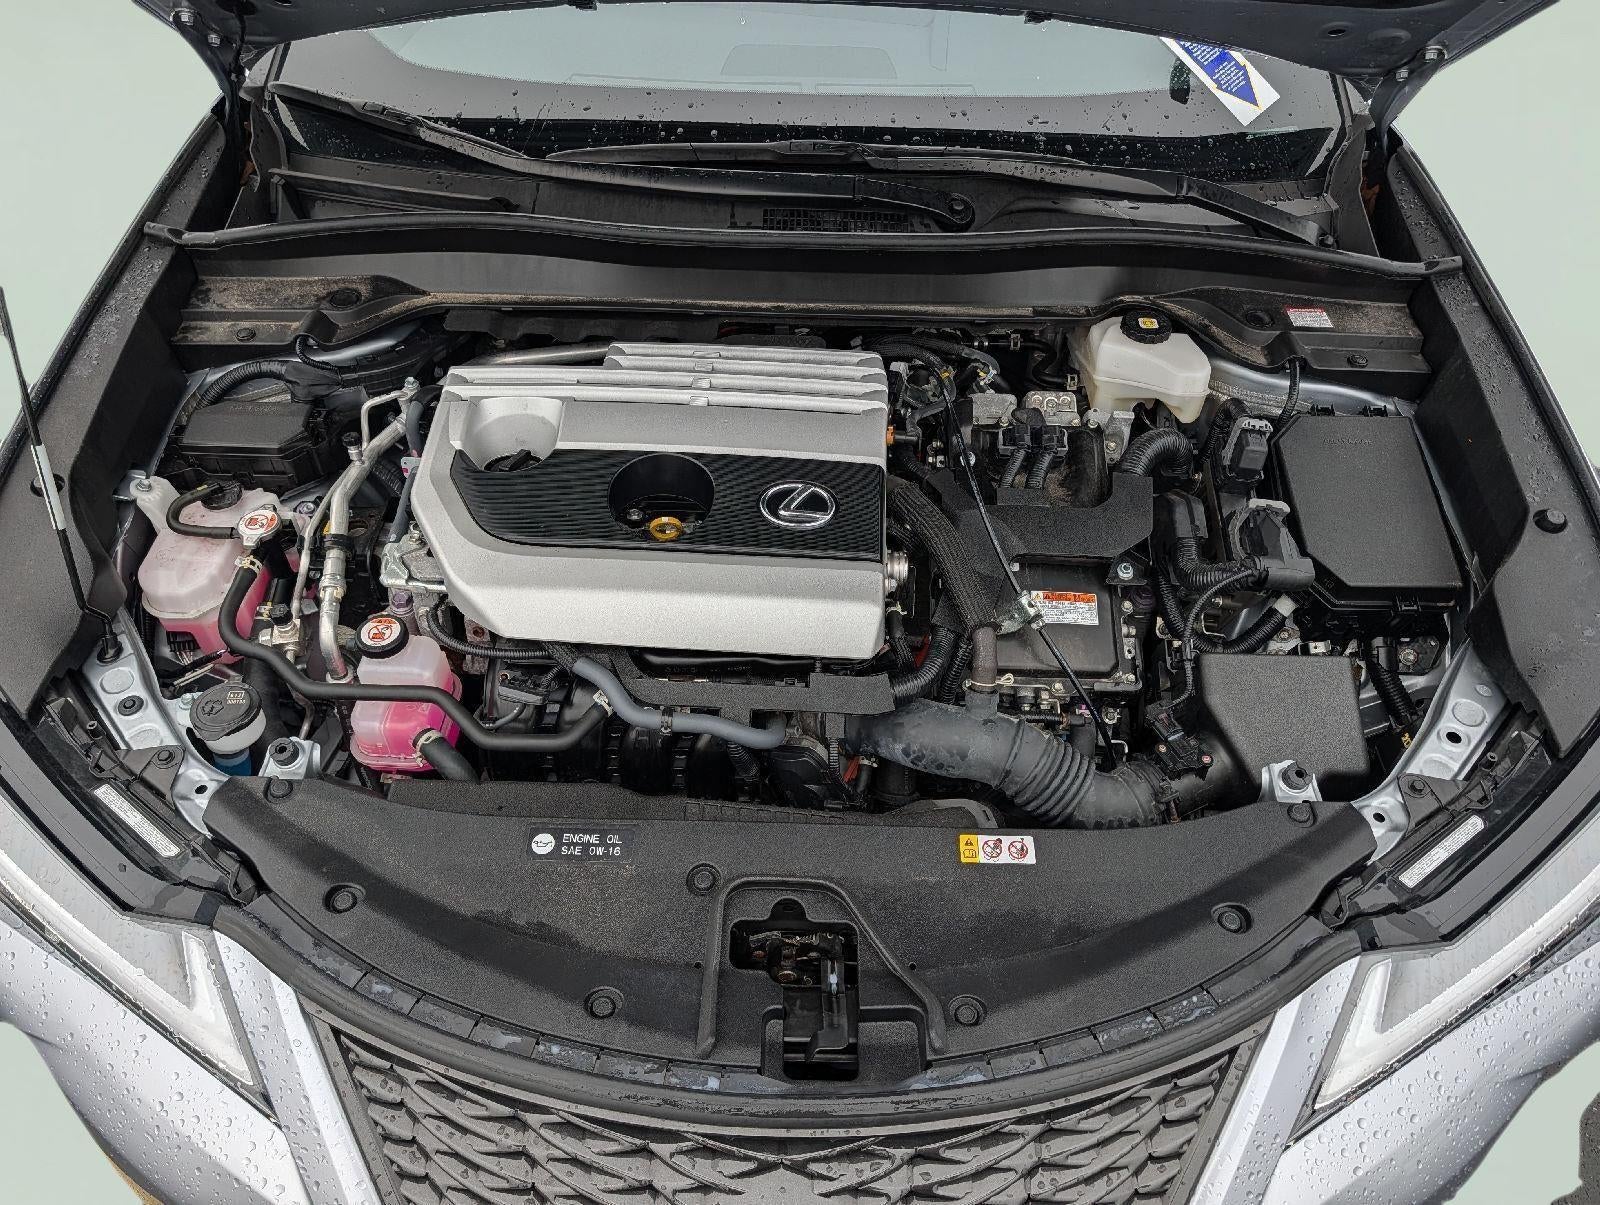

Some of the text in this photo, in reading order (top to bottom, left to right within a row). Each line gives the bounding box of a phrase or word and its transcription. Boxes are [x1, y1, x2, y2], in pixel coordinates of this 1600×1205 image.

[562, 833, 622, 844] ENGINE OIL
[561, 846, 621, 856] SAE 0W-16
